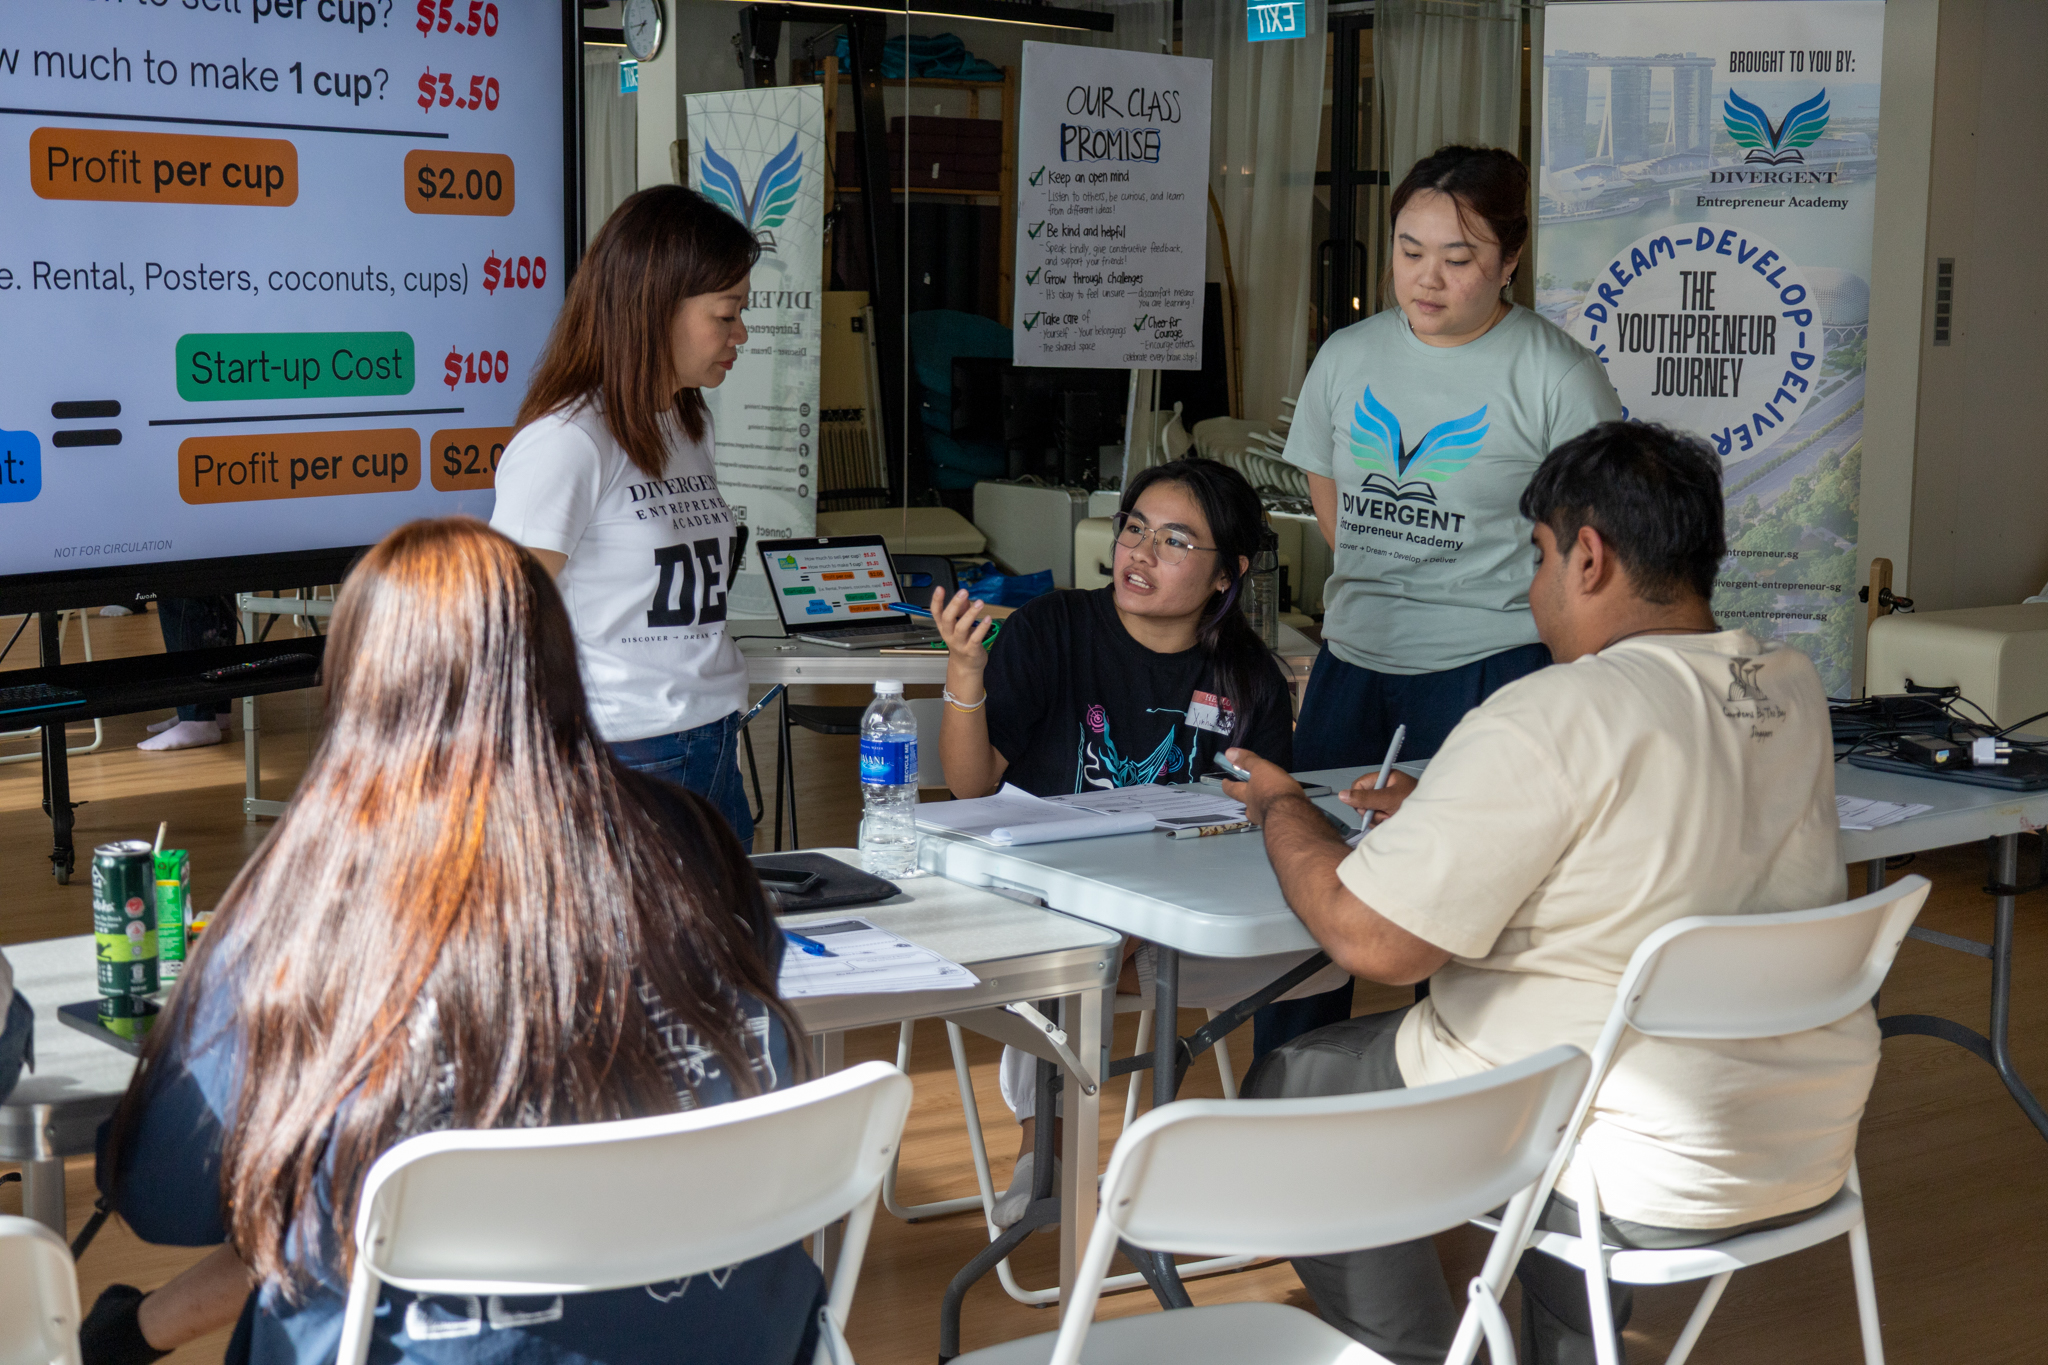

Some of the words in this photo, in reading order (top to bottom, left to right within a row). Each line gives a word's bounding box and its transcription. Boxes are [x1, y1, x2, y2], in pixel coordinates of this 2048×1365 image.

[253, 0, 303, 23] per
[317, 0, 393, 33] cup?
[416, 0, 499, 38] $5.50
[1730, 50, 1785, 73] BROUGHT
[1790, 51, 1804, 73] TO
[1809, 51, 1832, 73] YOU
[1836, 51, 1856, 73] BY:
[33, 48, 132, 82] much
[144, 50, 178, 86] to
[190, 57, 279, 92] make
[289, 62, 303, 94] 1
[313, 68, 389, 106] cup?
[417, 66, 500, 114] $3.50
[1067, 86, 1123, 118] OUR
[1128, 88, 1182, 123] CLASS
[1061, 123, 1160, 163] PROMISE
[48, 146, 141, 184] Profit
[153, 160, 211, 193] per
[222, 163, 284, 197] cup
[417, 166, 502, 201] $2.00
[1049, 170, 1071, 187] Keep
[1075, 173, 1085, 183] an
[1089, 172, 1108, 186] open
[1110, 170, 1129, 182] mind
[1710, 171, 1837, 184] DIVERGENT
[1048, 204, 1064, 215] from
[1109, 190, 1118, 201] be
[1150, 189, 1163, 200] and
[1696, 196, 1785, 210] Entrepreneur
[1788, 196, 1849, 210] Academy
[1047, 223, 1058, 238] Be
[1062, 223, 1080, 237] kind
[1083, 223, 1099, 237] and
[1101, 224, 1126, 240] helpful
[482, 249, 546, 296] $100
[1045, 255, 1057, 266] and
[1061, 256, 1083, 268] support
[1086, 257, 1099, 268] your
[33, 261, 135, 295] Rental,
[146, 262, 259, 296] Posters,
[268, 265, 395, 297] coconuts,
[403, 263, 468, 298] cups)
[1044, 270, 1066, 285] Grow
[1073, 271, 1103, 286] through
[1107, 271, 1143, 286] challenges
[1679, 271, 1717, 311] THE
[1086, 288, 1099, 299] feel
[1040, 311, 1060, 325] Take
[1063, 313, 1078, 325] care
[1082, 309, 1091, 323] of
[1617, 313, 1777, 355] YOUTHPRENEUR
[192, 350, 320, 389] Start-up
[332, 348, 402, 381] Cost
[443, 345, 509, 391] $100
[1651, 357, 1743, 398] JOURNEY
[195, 451, 279, 487] Profit
[290, 455, 342, 489] per
[352, 452, 408, 483] cup
[443, 442, 504, 479] $2.0
[626, 475, 717, 502] DIVERGEN
[635, 497, 726, 520] ENTREPRENE
[673, 512, 730, 530] ACADEMY
[1342, 492, 1466, 533] DIVERGENT
[54, 547, 78, 558] NOT
[79, 545, 101, 556] FOR
[103, 540, 173, 554] CIRCULATION
[1366, 545, 1388, 557] Dream
[1405, 532, 1463, 551] Academy
[621, 635, 669, 643] DISCOVER
